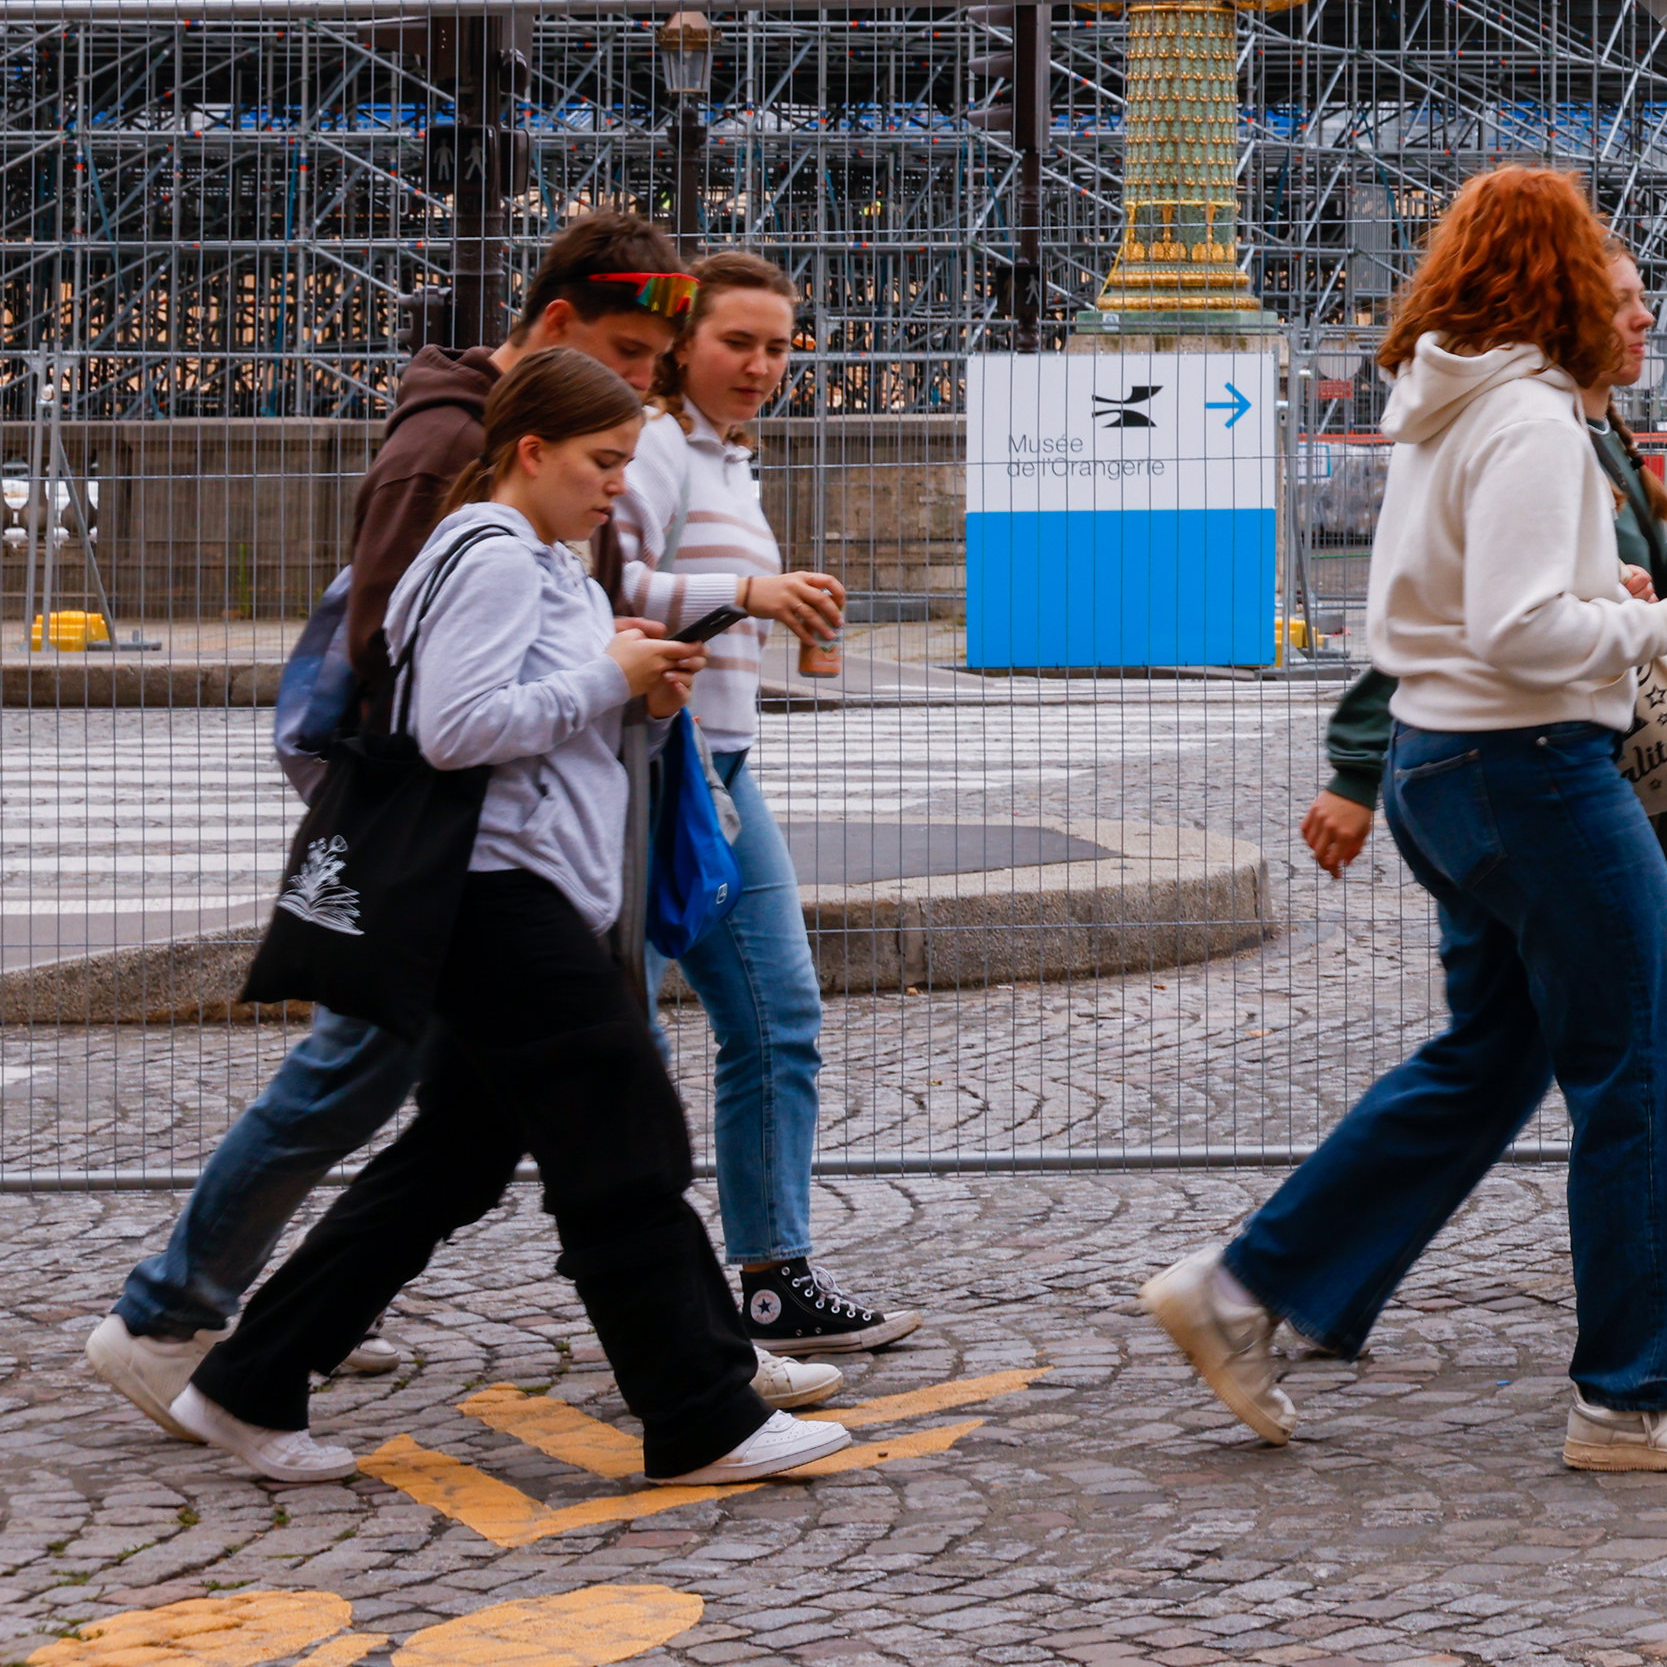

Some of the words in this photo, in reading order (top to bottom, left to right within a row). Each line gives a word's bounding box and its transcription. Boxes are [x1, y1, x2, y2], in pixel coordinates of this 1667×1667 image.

[1008, 433, 1083, 453] Musée
[1007, 458, 1035, 477] de
[1042, 456, 1165, 481] l'Orangerie
